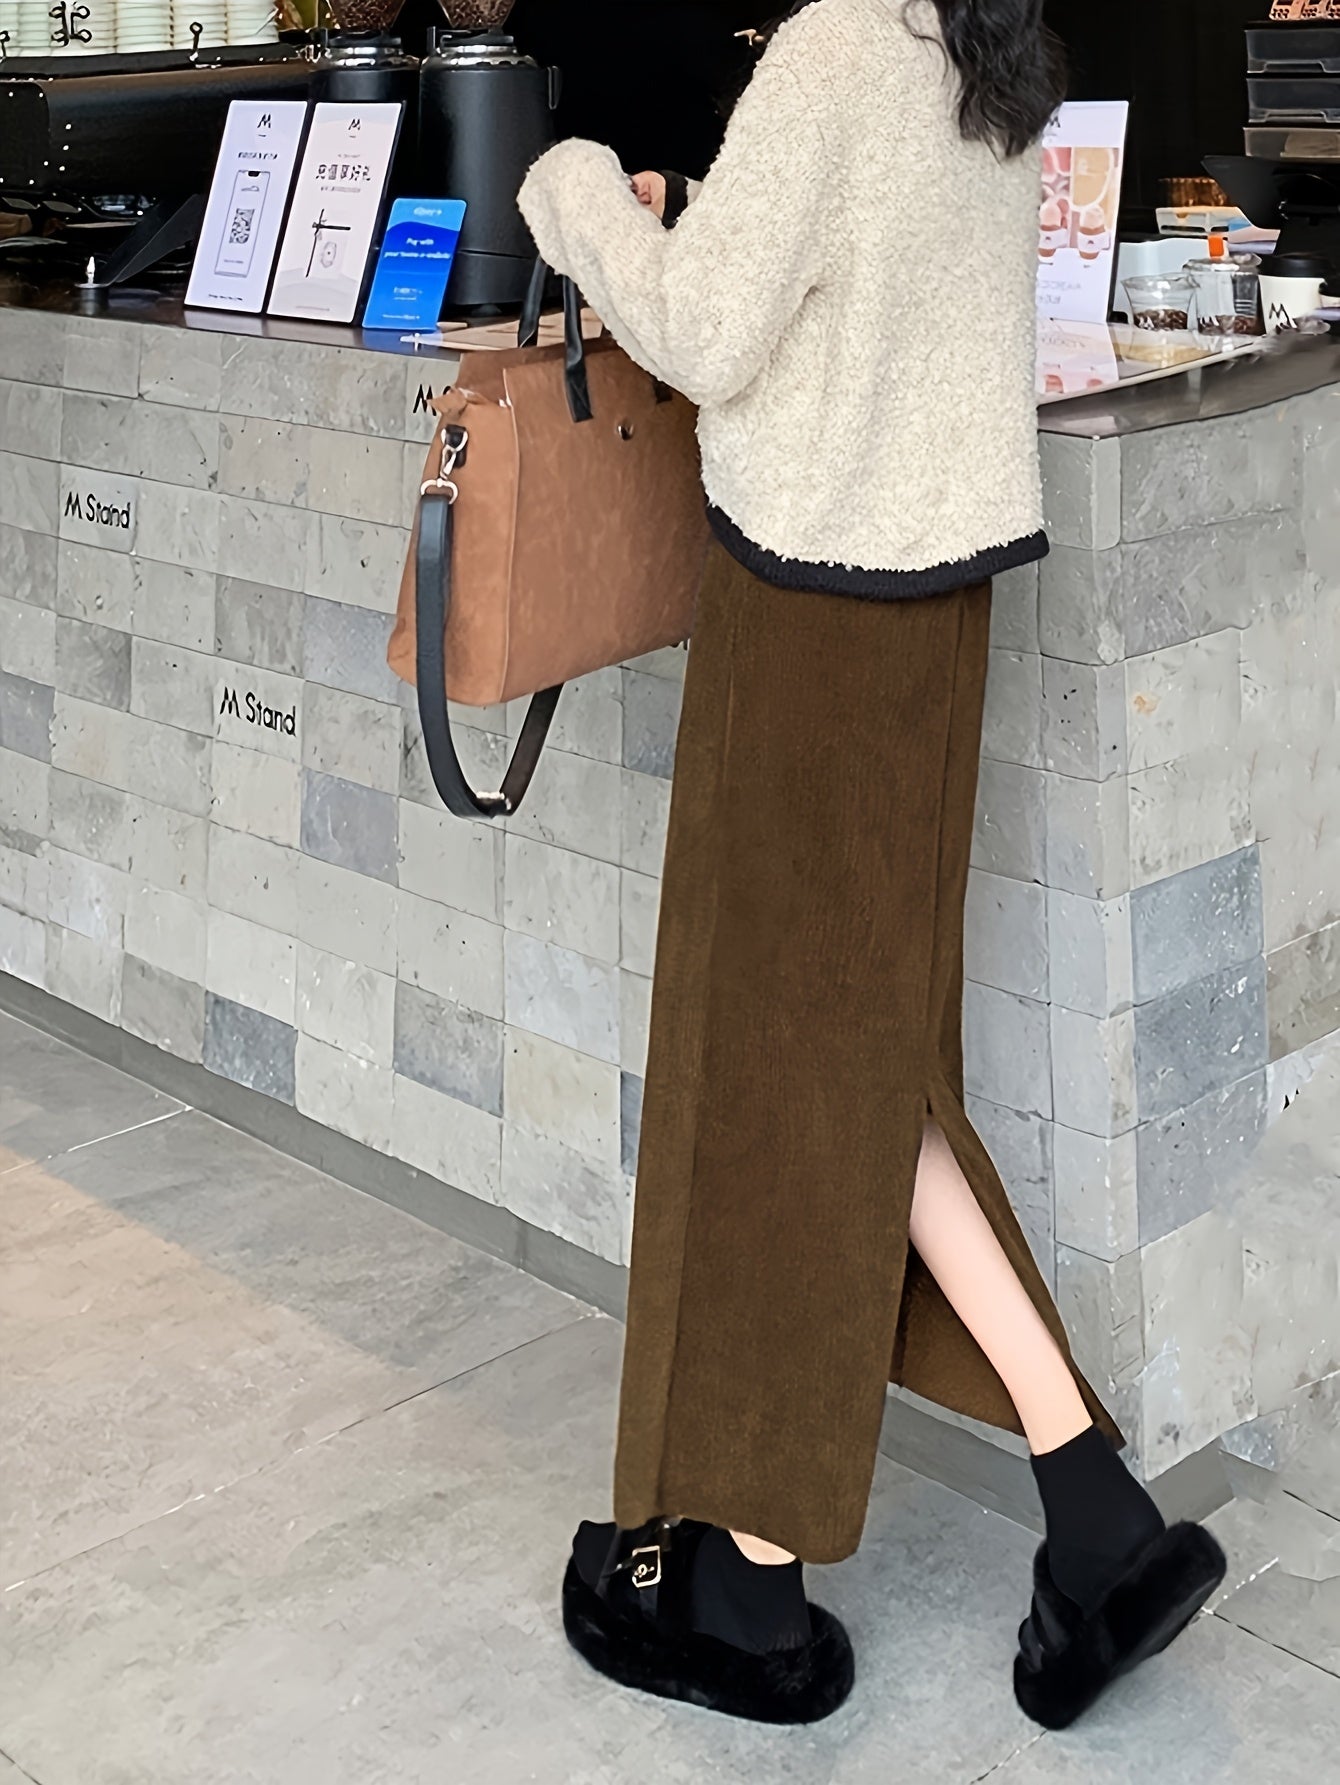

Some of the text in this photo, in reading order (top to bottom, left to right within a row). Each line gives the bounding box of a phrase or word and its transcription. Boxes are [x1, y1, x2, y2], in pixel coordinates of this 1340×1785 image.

[64, 491, 131, 529] M Stand
[219, 686, 297, 737] M Stand
